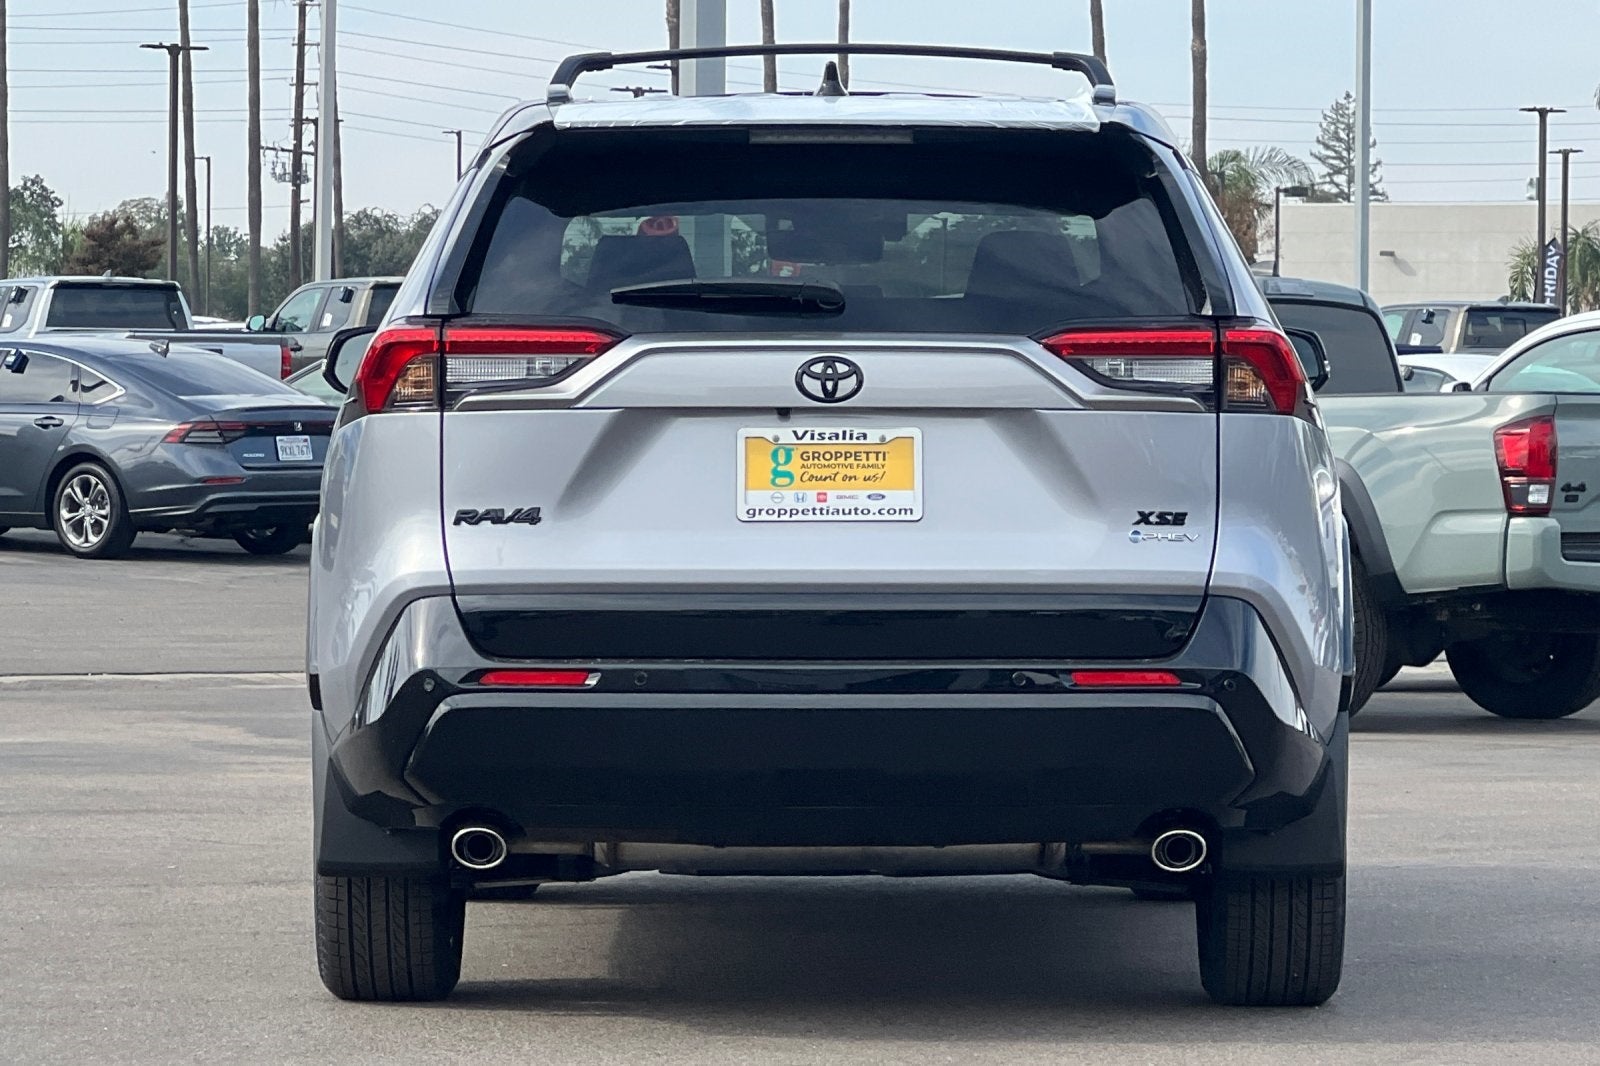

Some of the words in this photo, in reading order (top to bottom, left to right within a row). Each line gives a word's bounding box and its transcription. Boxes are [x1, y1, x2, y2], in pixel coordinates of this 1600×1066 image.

[792, 430, 868, 441] Visalia
[800, 451, 887, 462] GROPPETTI
[800, 471, 839, 483] Count
[841, 474, 858, 482] on
[863, 471, 886, 483] us!
[453, 507, 542, 525] RAV4
[745, 505, 914, 518] groppettiauto.com
[1132, 510, 1188, 526] XSE
[1142, 532, 1199, 543] PHEV
